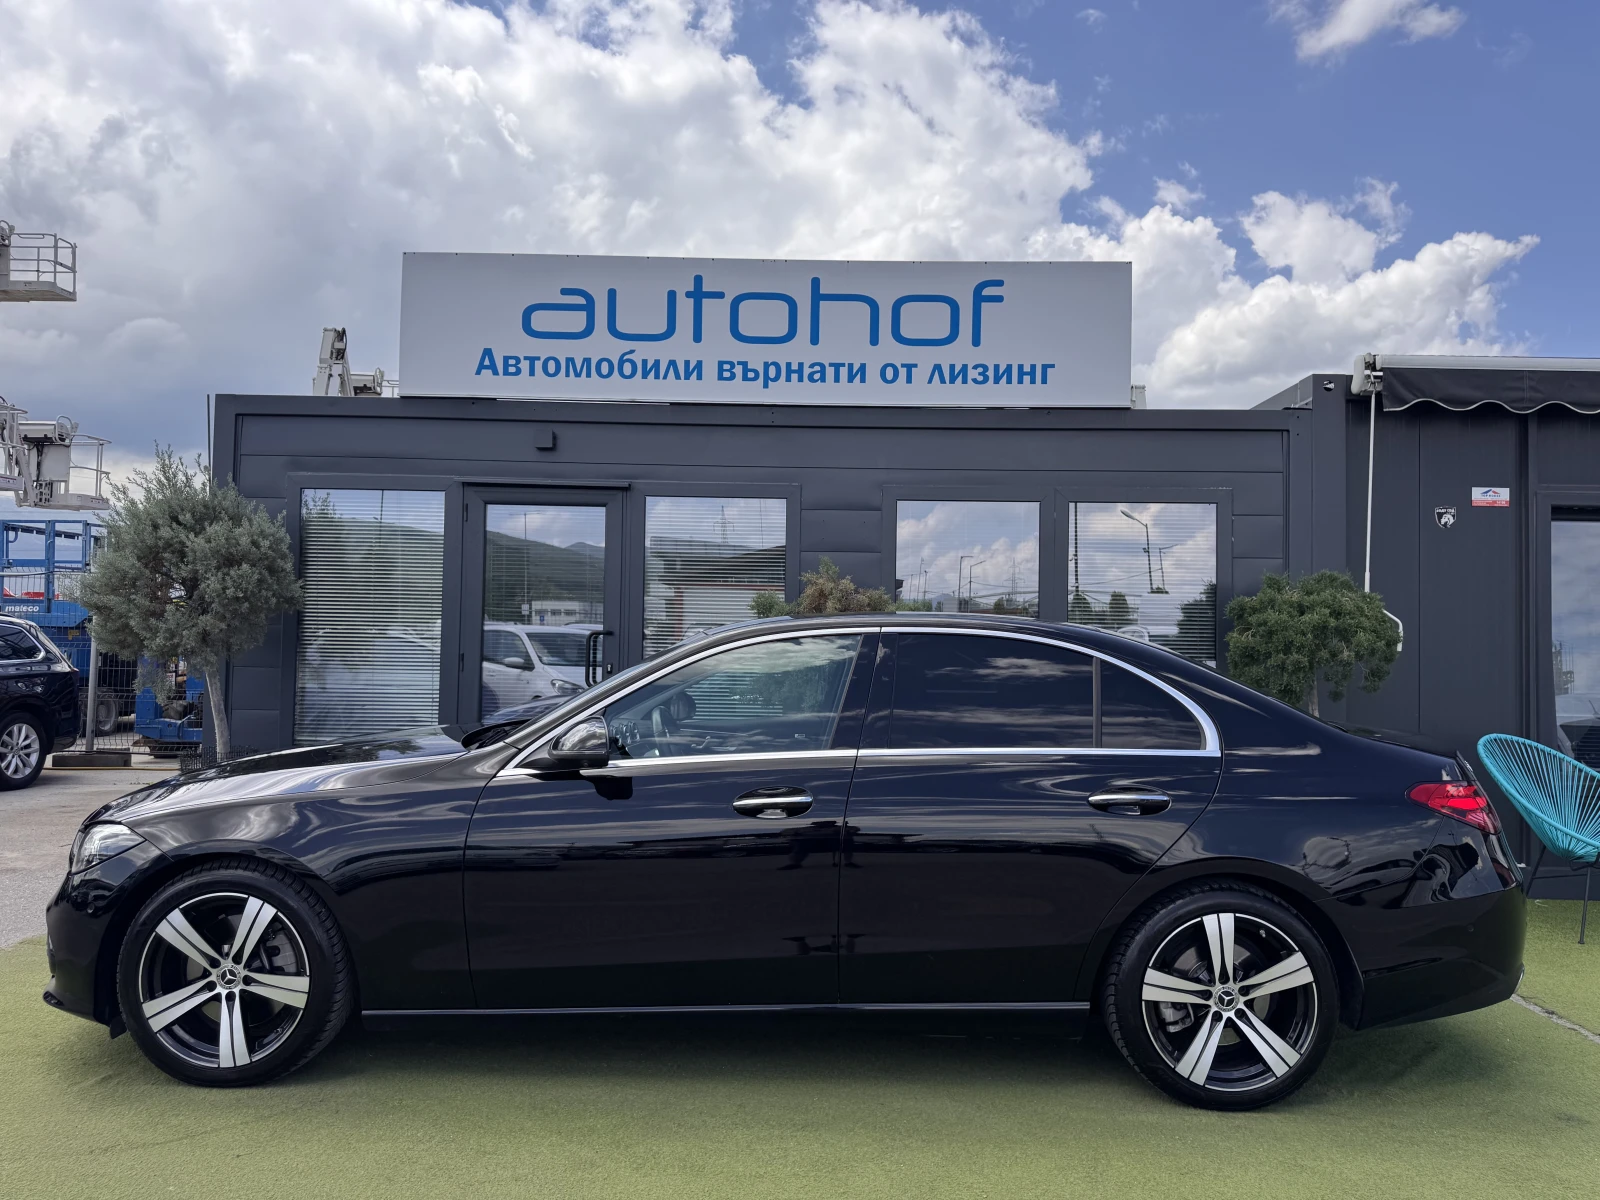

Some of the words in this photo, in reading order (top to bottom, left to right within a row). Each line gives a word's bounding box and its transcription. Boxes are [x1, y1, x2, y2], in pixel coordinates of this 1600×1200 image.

[522, 274, 1005, 349] autohof
[475, 347, 704, 382] Автомобили
[717, 359, 867, 391] върнати
[880, 362, 919, 386] от
[927, 362, 1056, 386] лизинг
